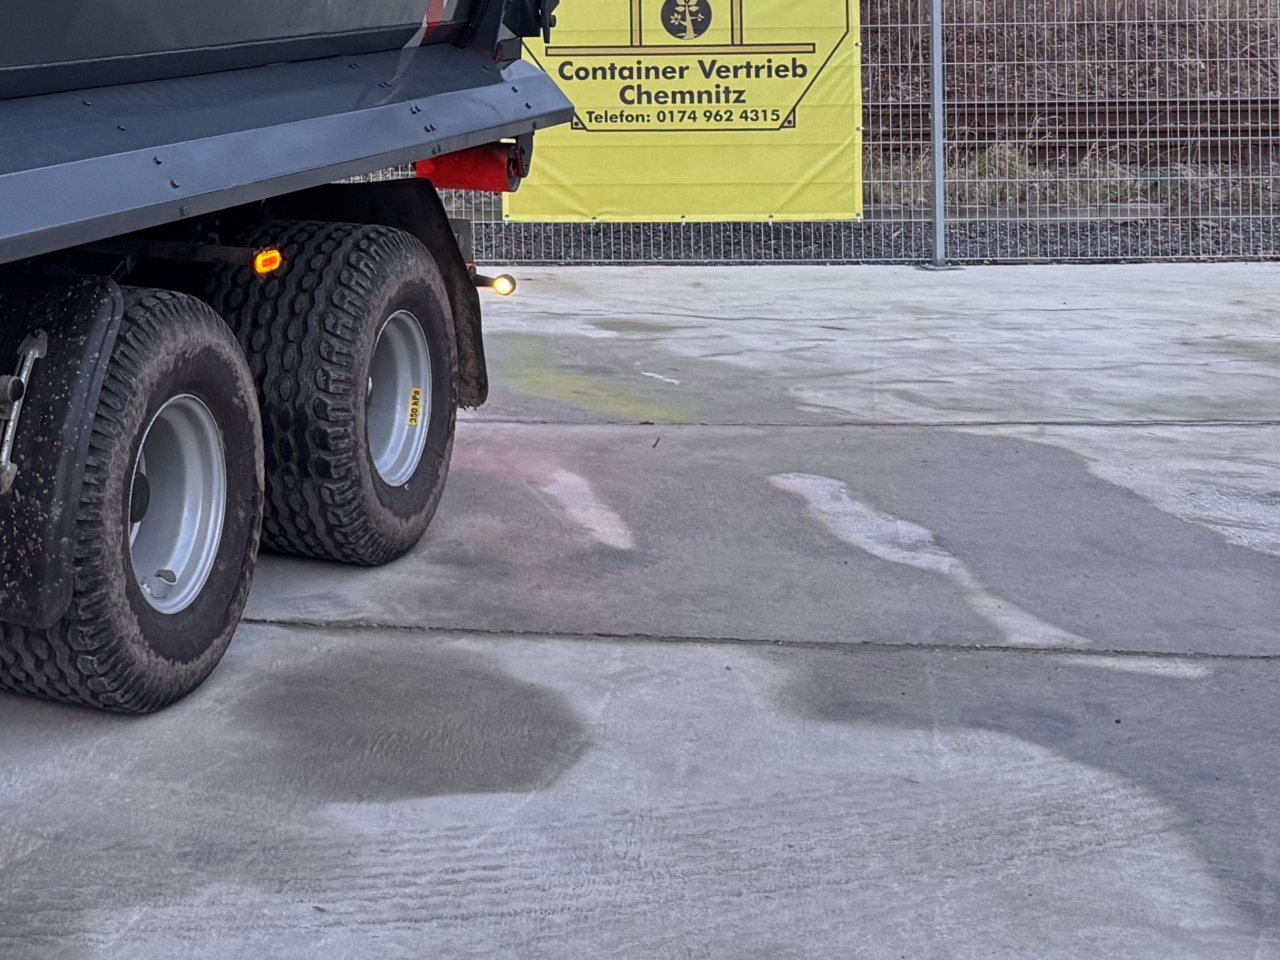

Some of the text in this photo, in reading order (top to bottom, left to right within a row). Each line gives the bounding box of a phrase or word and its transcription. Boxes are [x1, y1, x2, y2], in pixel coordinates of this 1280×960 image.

[558, 57, 808, 81] Container Vertrieb
[619, 83, 746, 105] Chemnitz
[586, 109, 780, 123] Telefon: 0174 962 4315
[409, 390, 420, 423] 350 kPa
